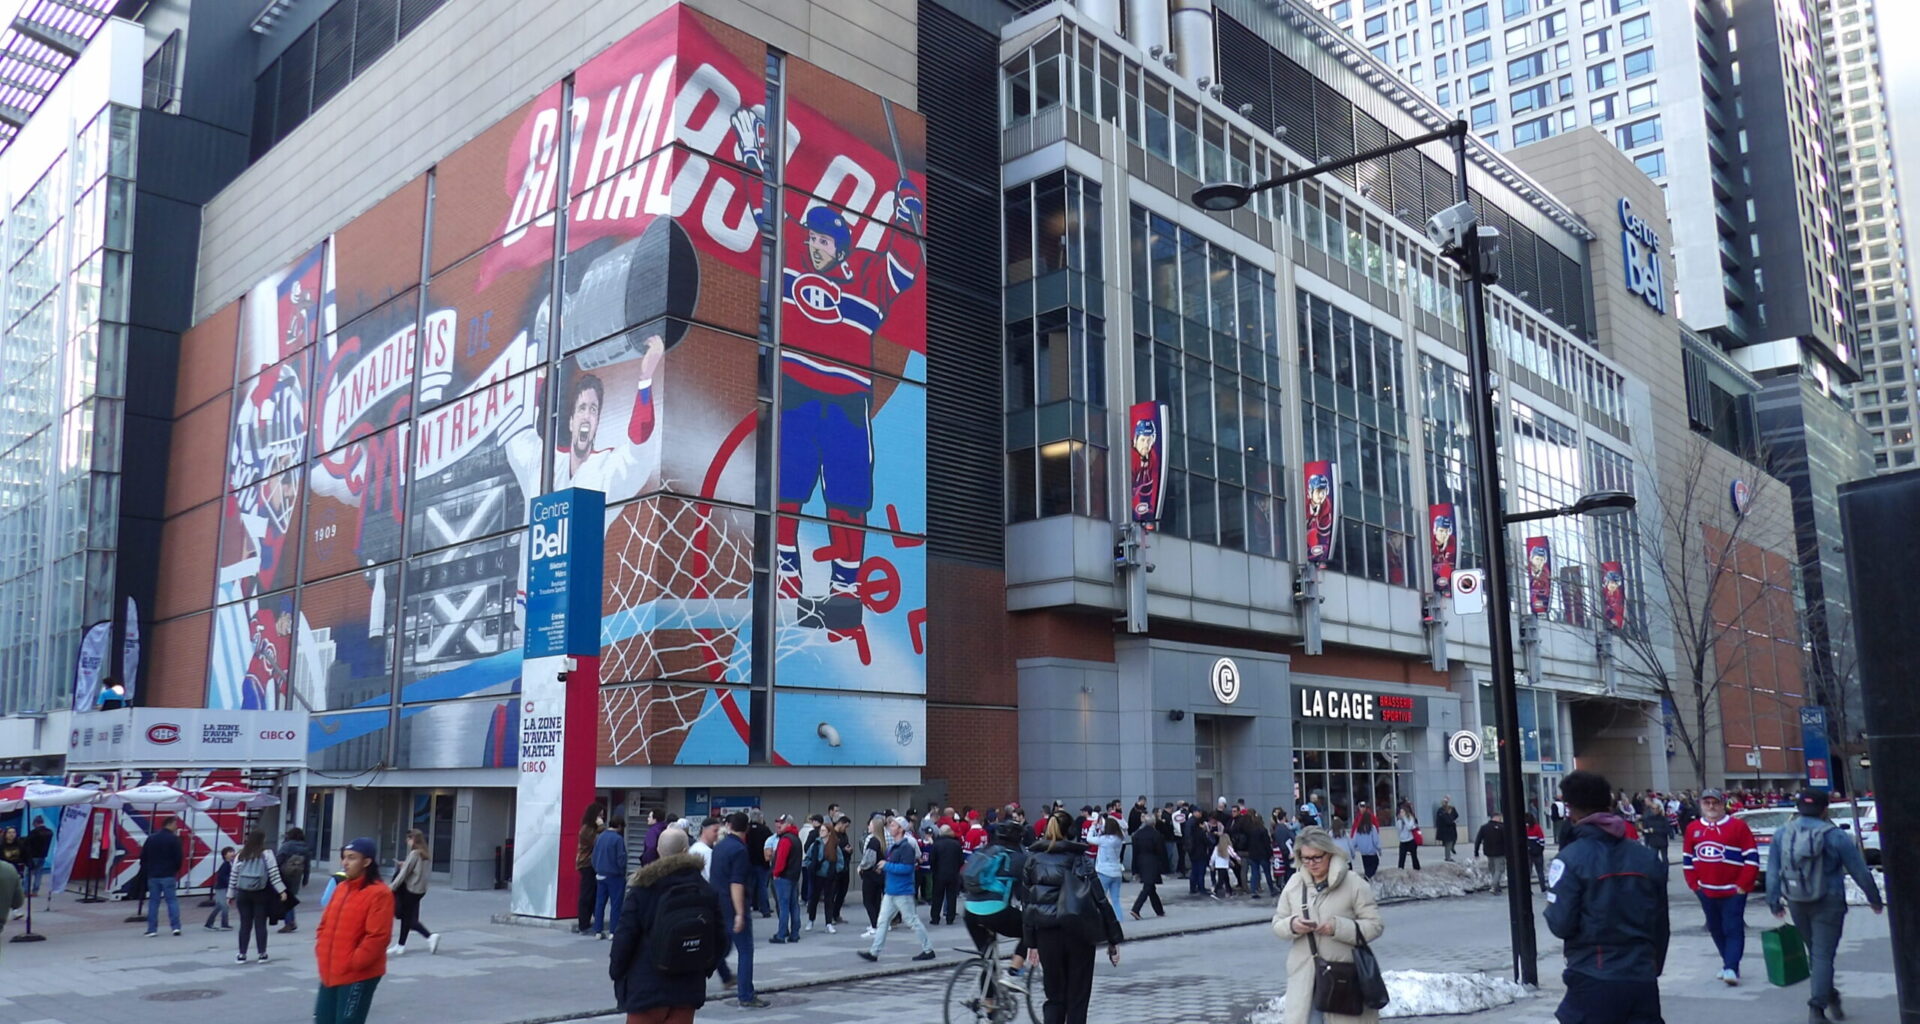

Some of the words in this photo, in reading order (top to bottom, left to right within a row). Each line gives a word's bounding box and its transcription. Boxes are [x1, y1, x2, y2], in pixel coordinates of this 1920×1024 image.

[502, 97, 590, 248] GO
[575, 54, 801, 253] HABS
[1618, 196, 1660, 253] Centre
[1621, 230, 1667, 316] Bell
[533, 501, 570, 522] Centre
[314, 525, 337, 542] 1909
[531, 517, 569, 561] Bell
[1301, 688, 1325, 718] LA
[1328, 691, 1374, 721] CAGE
[1378, 695, 1415, 709] BRASSERIE
[523, 718, 537, 730] LA
[537, 716, 562, 729] ZONE
[1382, 709, 1413, 723] SPORTIVE
[202, 723, 215, 731] LA
[216, 724, 240, 732] ZONE
[202, 736, 234, 744] MATCH
[259, 730, 285, 740] CIBC
[523, 731, 562, 744] D'AVANT
[522, 745, 555, 758] MATCH
[521, 762, 538, 773] CIBC
